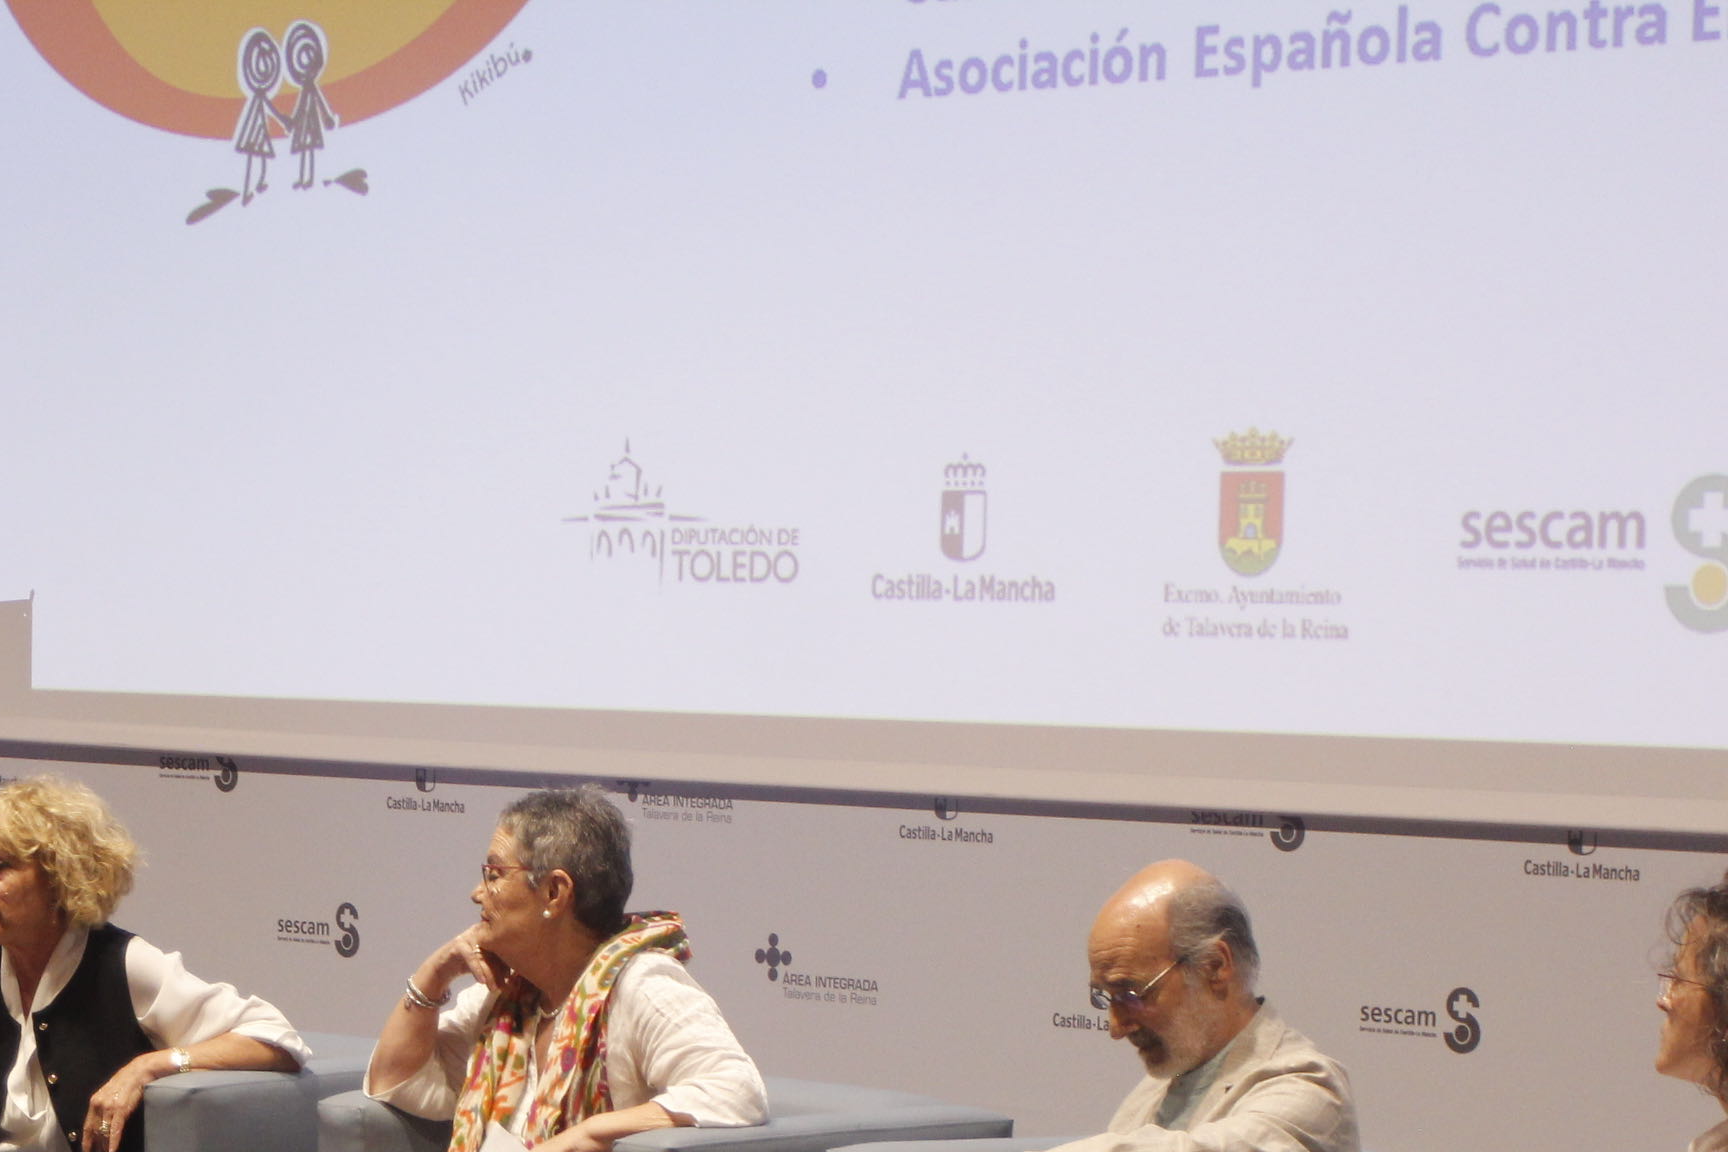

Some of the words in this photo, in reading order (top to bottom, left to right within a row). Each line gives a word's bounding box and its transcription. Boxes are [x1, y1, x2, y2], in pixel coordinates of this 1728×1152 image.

[898, 28, 1167, 99] Asociación
[1193, 6, 1443, 87] Española
[1465, 0, 1668, 57] Contra
[672, 525, 772, 546] DIPUTACIÓN
[777, 528, 799, 546] DE
[1459, 509, 1647, 549] sescam
[672, 549, 799, 583] TOLEDO
[979, 575, 1056, 603] Mancha
[1228, 584, 1342, 611] Ayuntamiento
[1162, 617, 1179, 638] de
[1185, 617, 1253, 639] Talavera
[1256, 619, 1277, 639] de
[1282, 619, 1296, 639] la
[1301, 619, 1349, 640] Reina
[159, 755, 210, 771] sescam
[432, 799, 465, 813] Mancha
[673, 796, 734, 810] INTEGRADA
[641, 807, 679, 820] Talavera
[681, 809, 693, 821] de
[954, 828, 994, 844] Mancha
[1592, 863, 1641, 882] Mancha
[277, 917, 330, 937] sescam
[815, 976, 878, 992] INTEGRADA
[783, 987, 821, 1001] Talavera
[823, 991, 836, 1002] de
[838, 991, 848, 1003] la
[850, 992, 877, 1006] Reina
[1360, 1005, 1437, 1028] sescam
